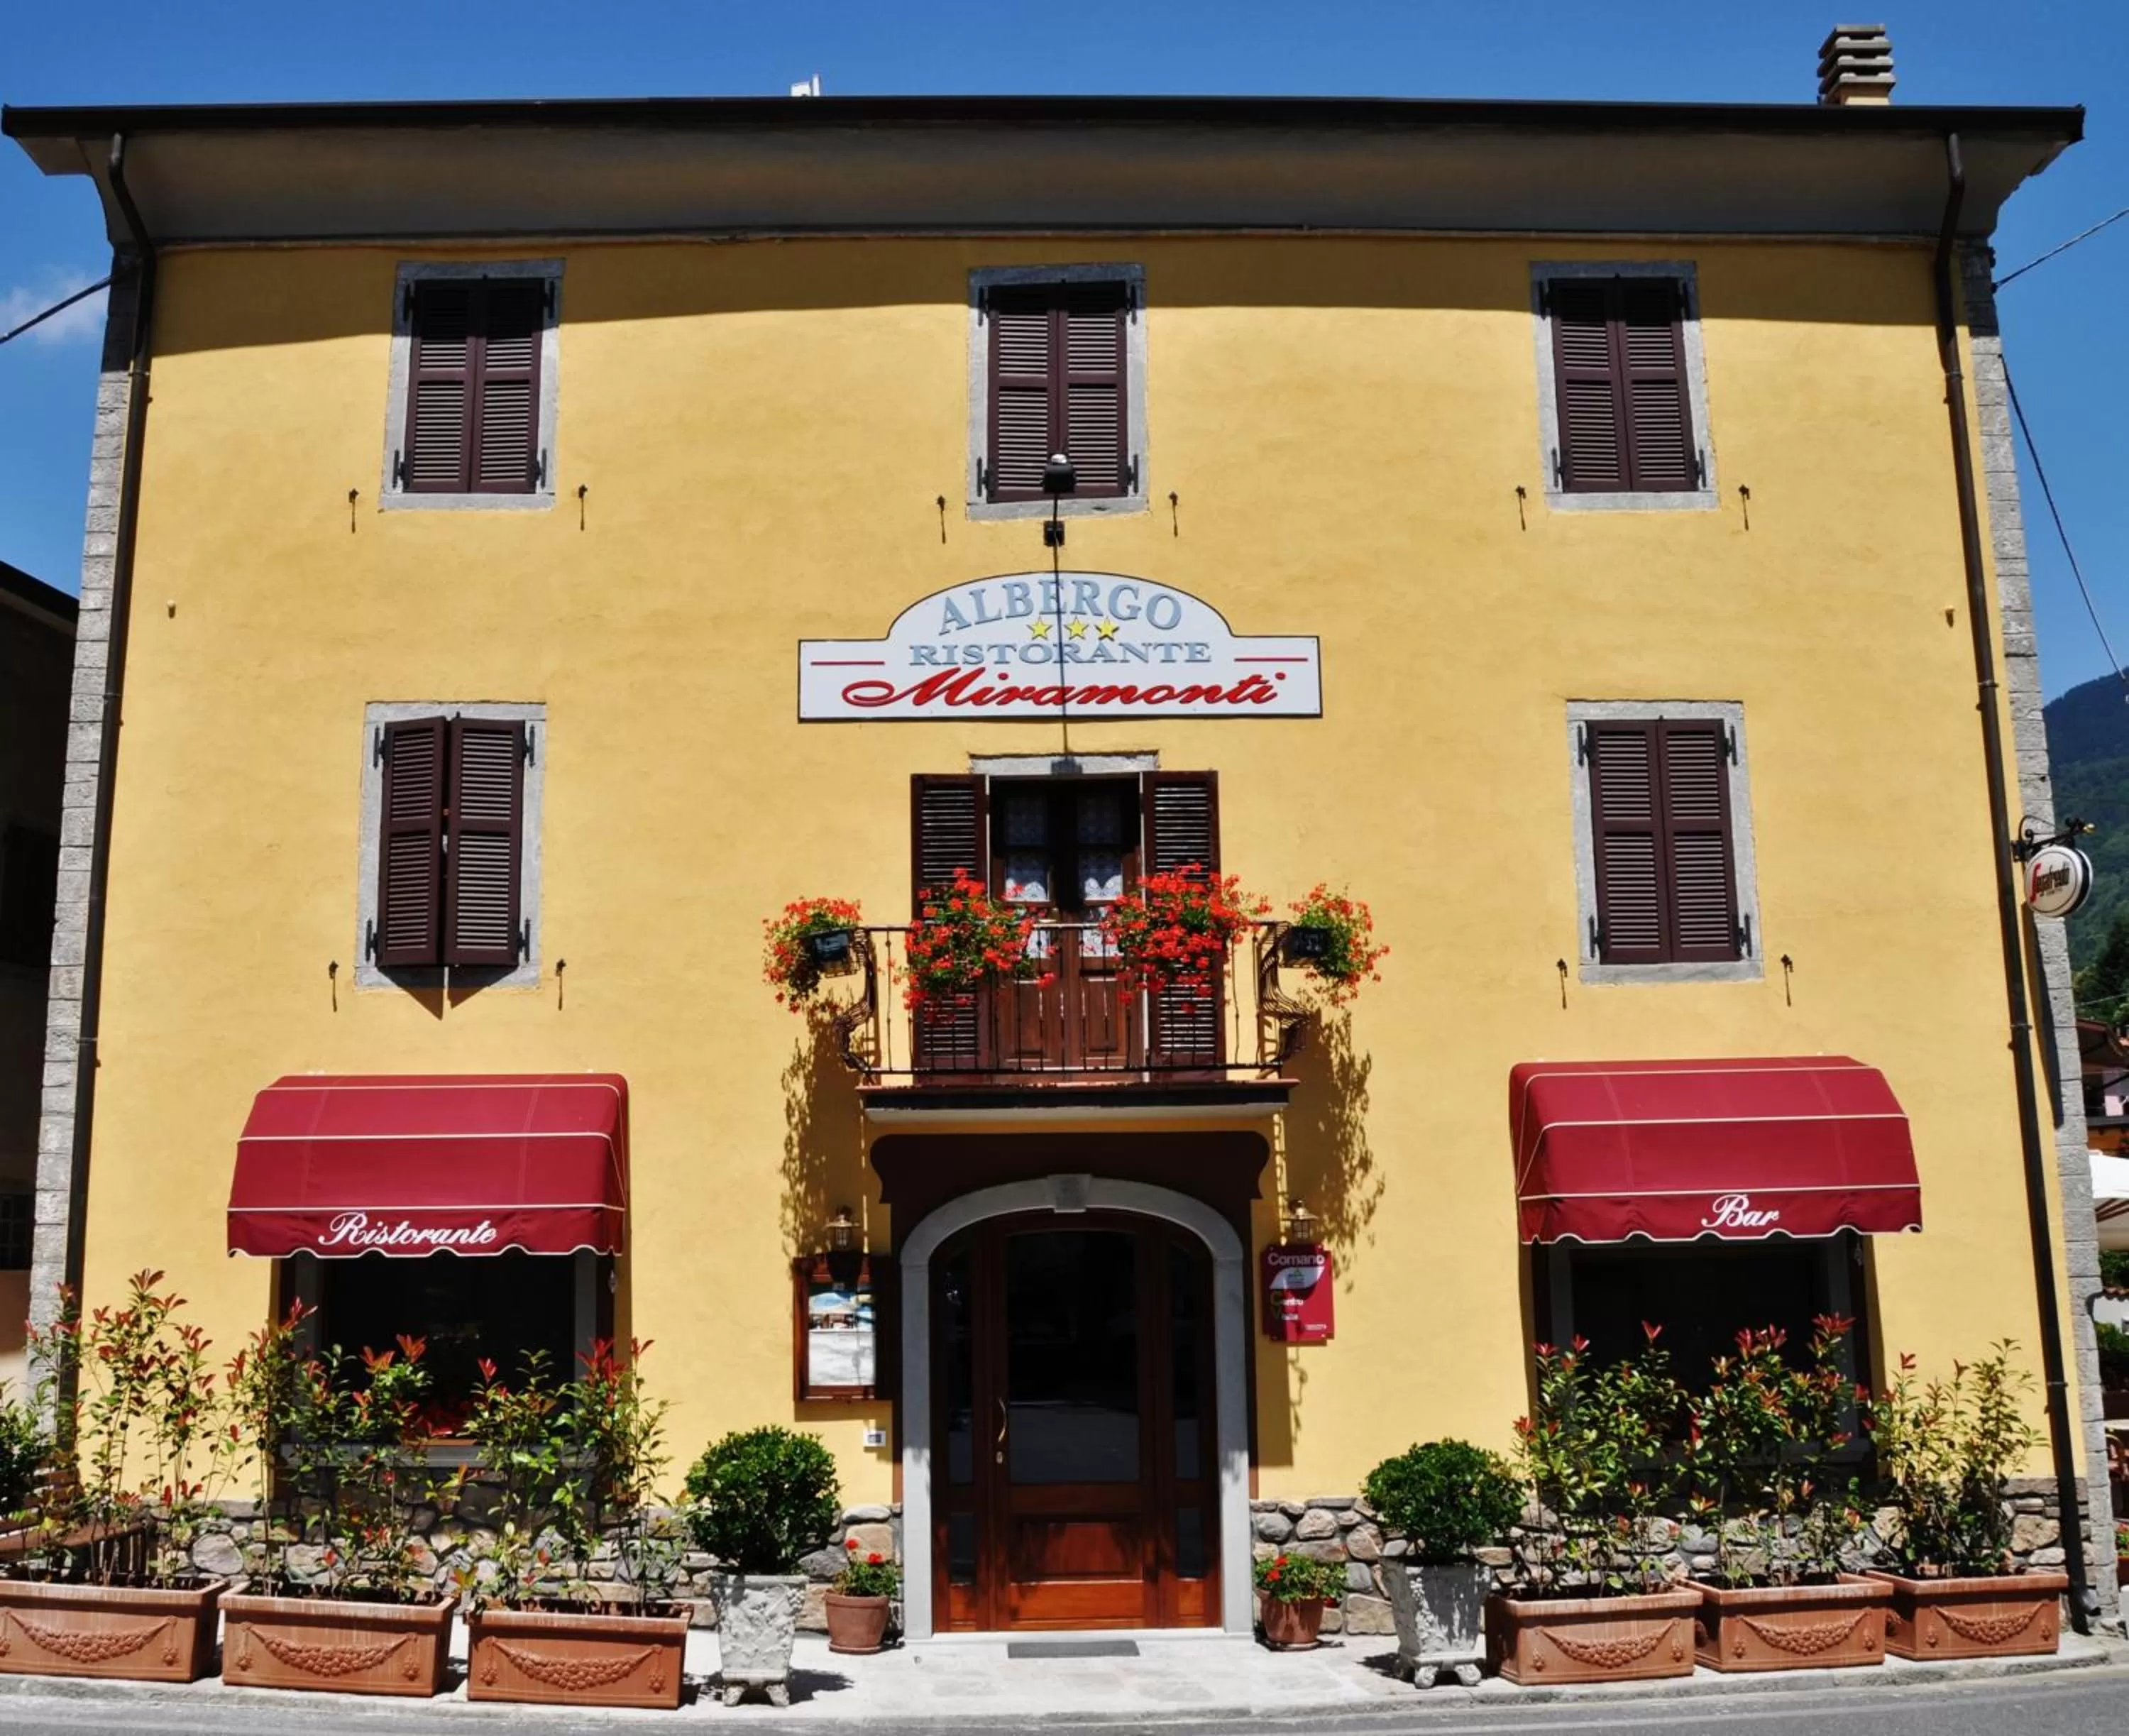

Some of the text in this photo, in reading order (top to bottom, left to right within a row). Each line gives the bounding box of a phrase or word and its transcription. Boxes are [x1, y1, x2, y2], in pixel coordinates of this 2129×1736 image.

[938, 579, 1182, 635] ALBERGO
[909, 642, 1211, 665] RISTORANTE
[842, 667, 1286, 707] Miramonti
[1701, 1194, 1779, 1227] Bar
[319, 1212, 497, 1245] Ristorante
[1268, 1253, 1325, 1265] Comano
